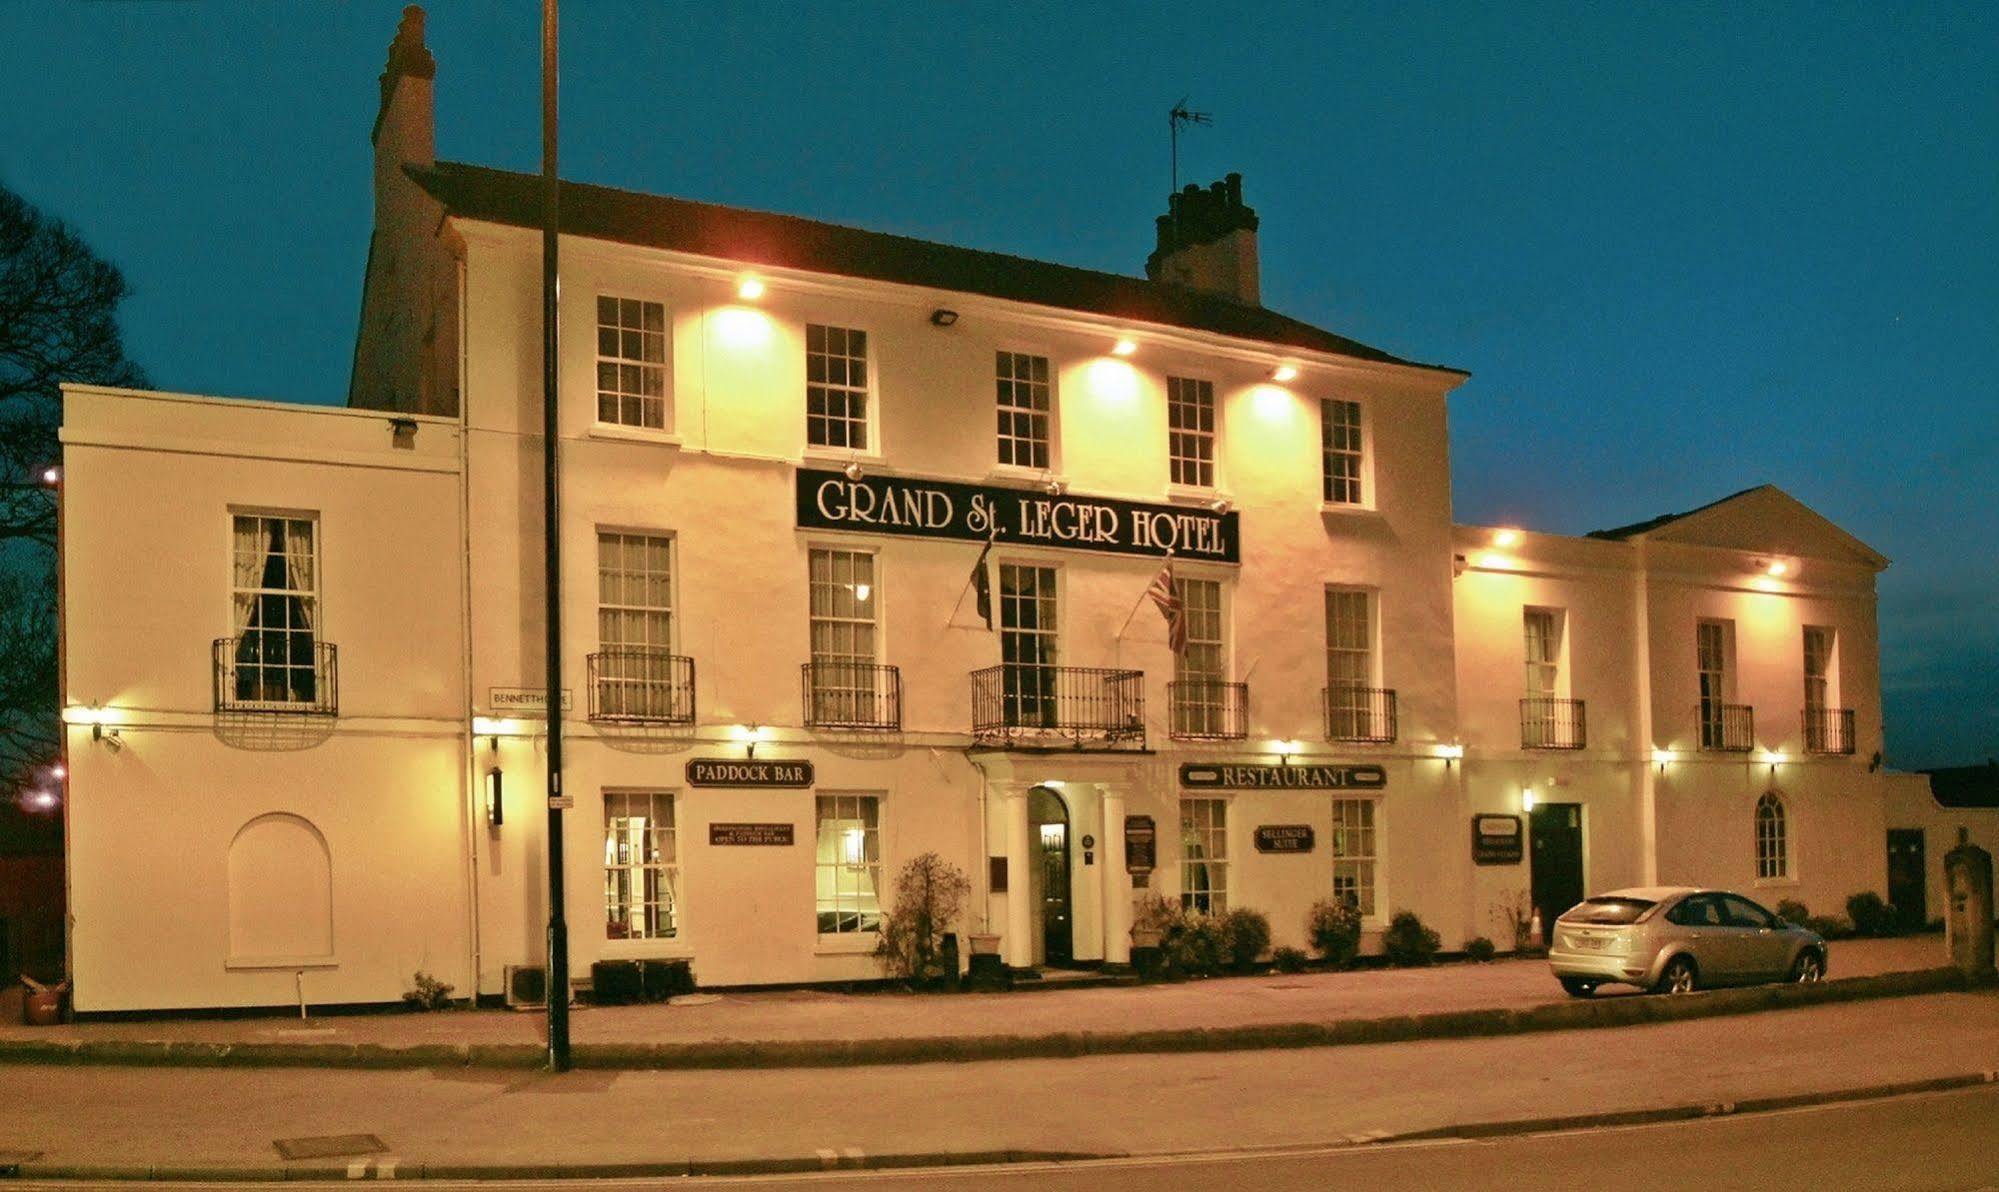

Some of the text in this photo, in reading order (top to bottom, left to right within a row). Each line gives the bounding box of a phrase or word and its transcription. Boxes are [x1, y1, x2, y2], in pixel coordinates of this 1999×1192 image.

[816, 480, 954, 530] GRAND
[1018, 500, 1119, 545] LEGER
[1131, 511, 1226, 556] HOTEL
[494, 694, 568, 706] BENNETTHE
[696, 765, 804, 781] PADDOCK BAR
[1223, 768, 1349, 786] RESTAURANT
